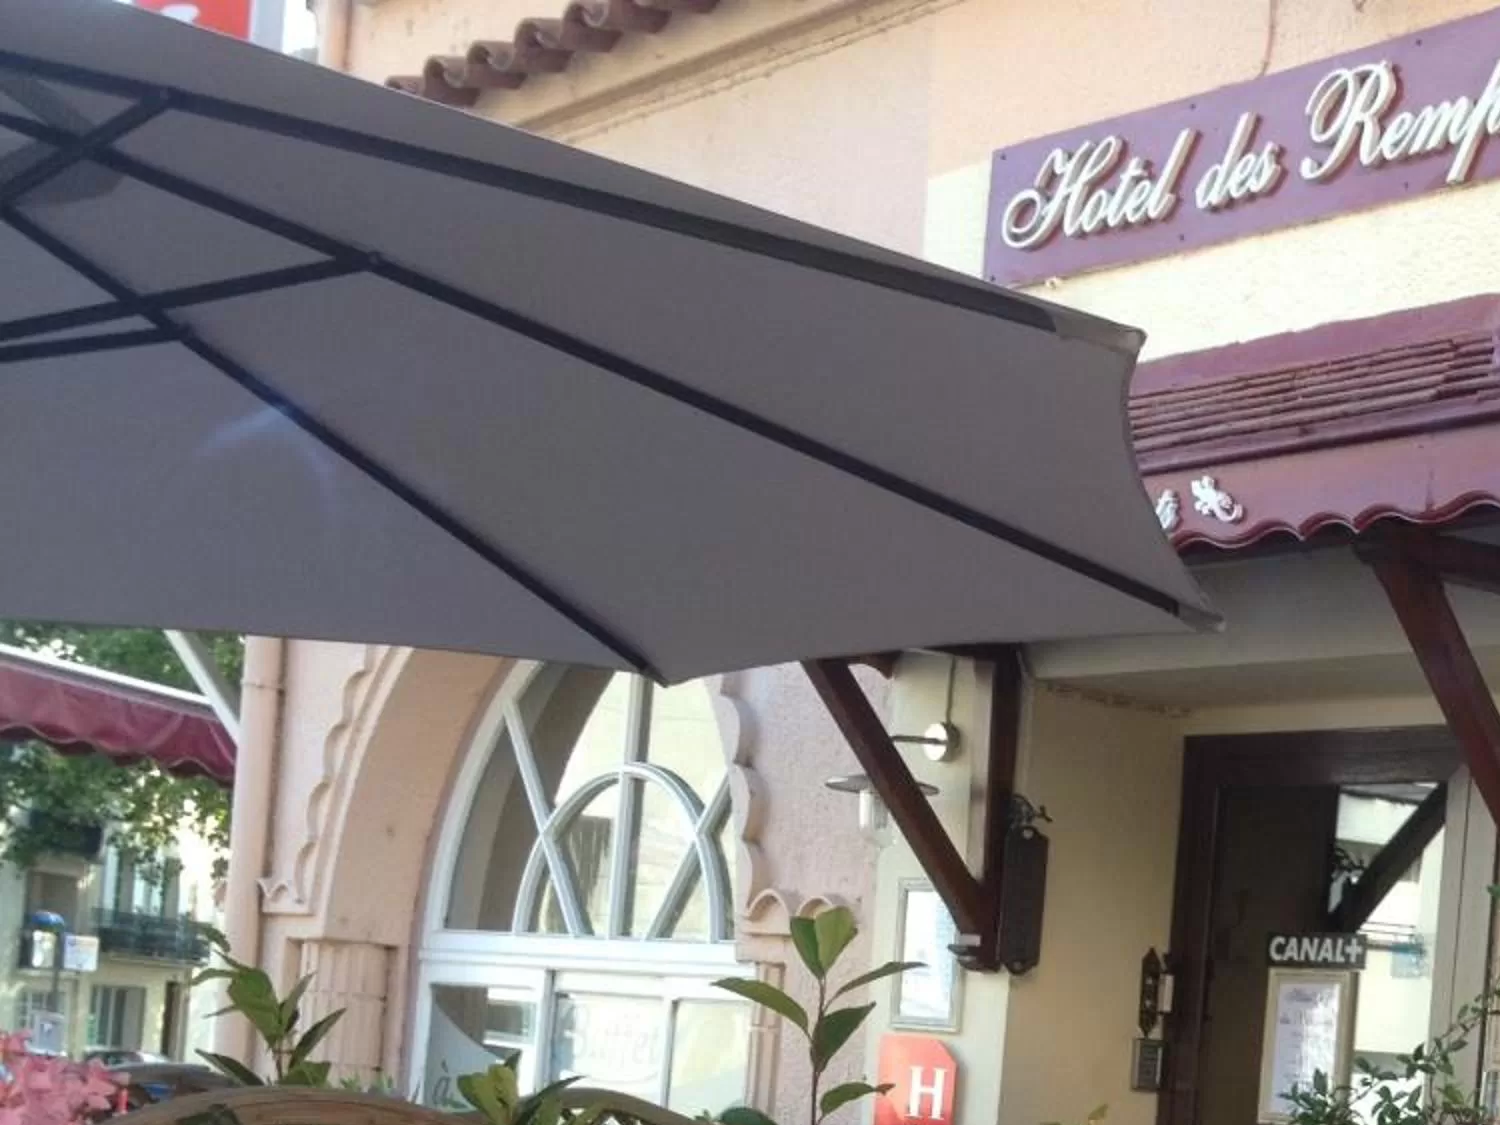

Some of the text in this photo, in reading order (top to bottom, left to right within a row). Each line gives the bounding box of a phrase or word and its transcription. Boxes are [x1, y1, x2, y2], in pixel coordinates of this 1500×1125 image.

[1001, 136, 1197, 249] Hotel
[1195, 111, 1281, 211] des
[1268, 935, 1364, 964] CANAL+
[904, 1064, 948, 1121] H
